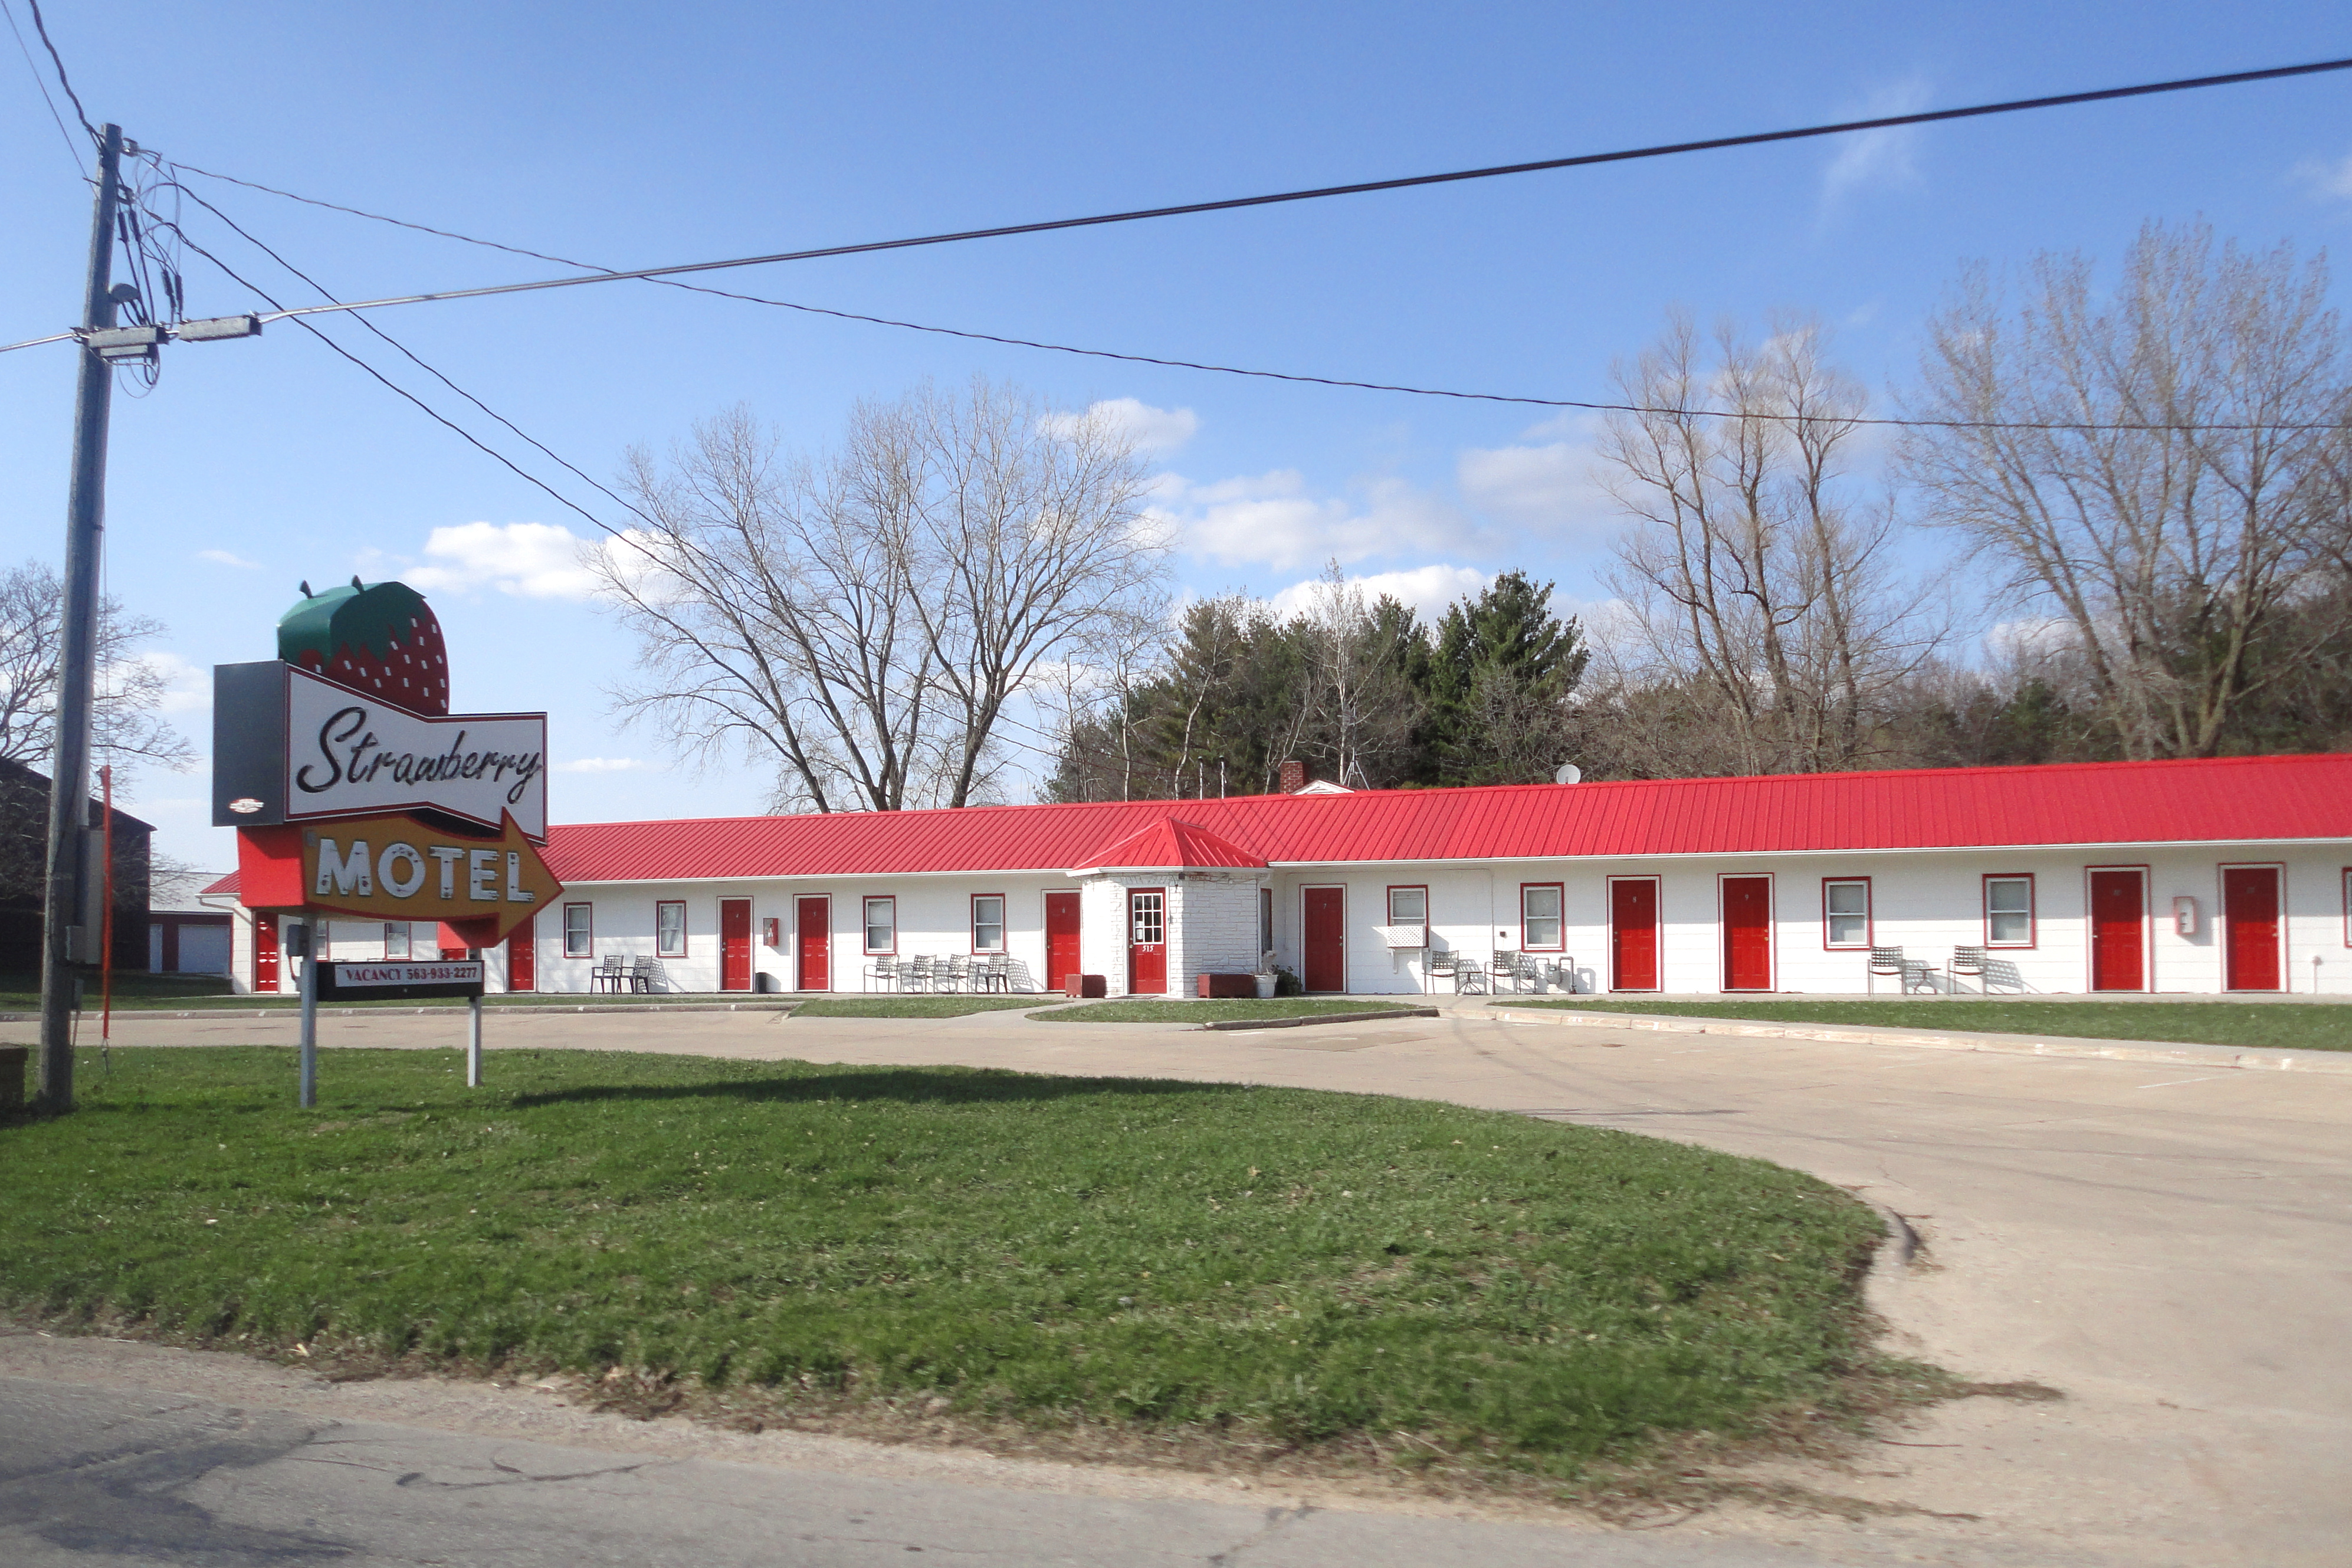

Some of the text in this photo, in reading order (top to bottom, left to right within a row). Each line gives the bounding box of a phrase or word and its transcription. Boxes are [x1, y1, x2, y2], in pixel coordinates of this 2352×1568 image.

[296, 706, 542, 805] Strawberry
[316, 838, 536, 903] MOTEL
[346, 967, 477, 982] VACANCY 563-933-2277
